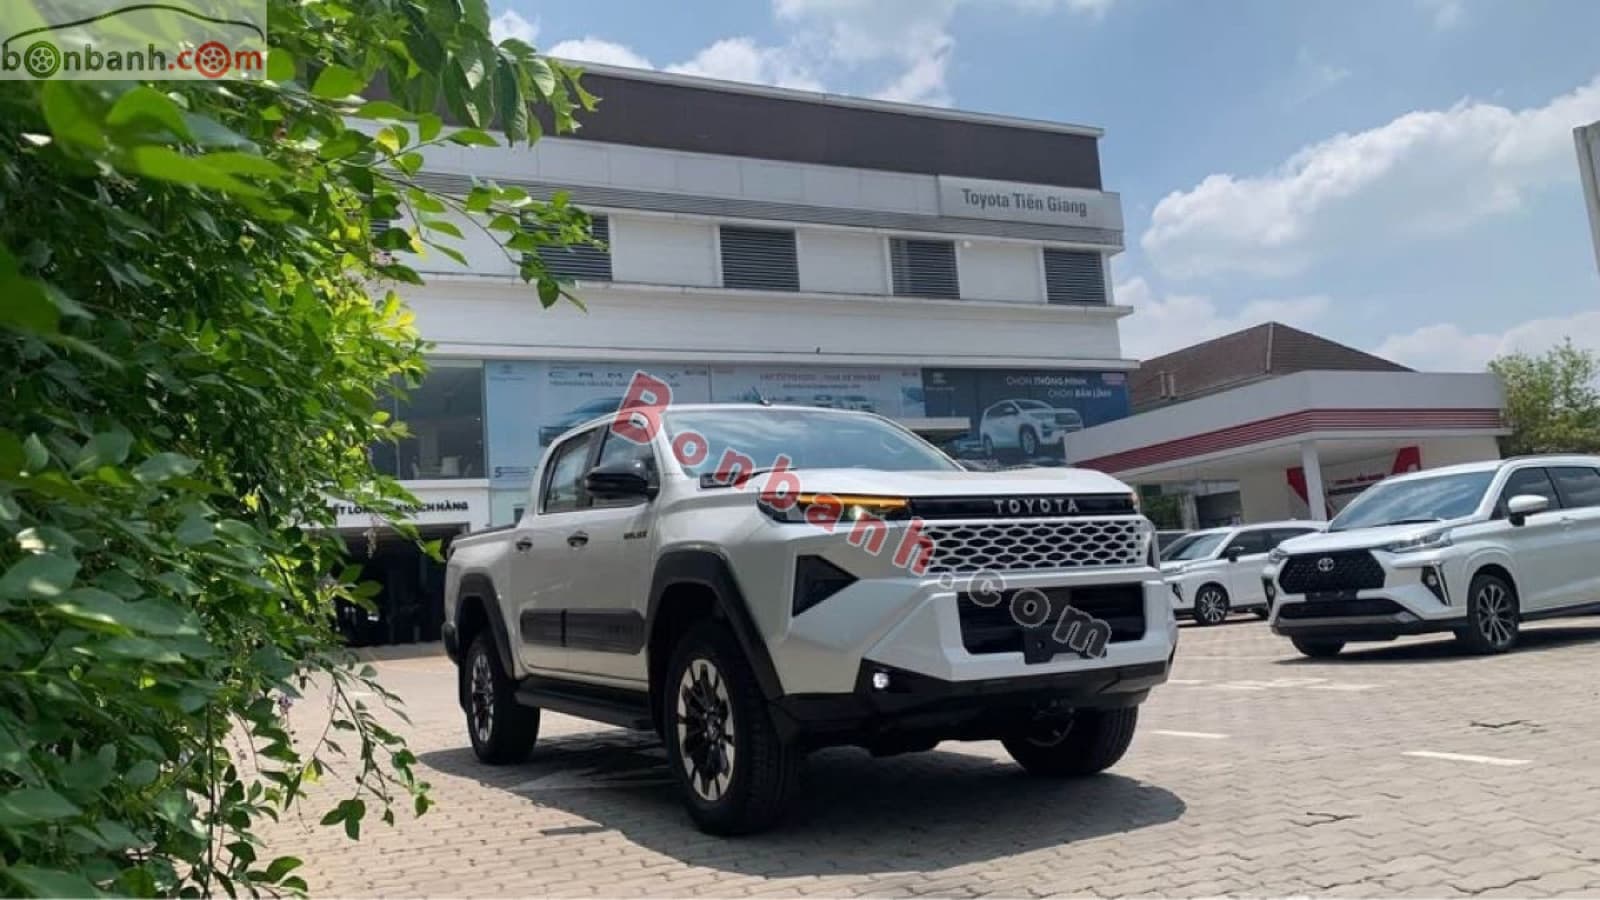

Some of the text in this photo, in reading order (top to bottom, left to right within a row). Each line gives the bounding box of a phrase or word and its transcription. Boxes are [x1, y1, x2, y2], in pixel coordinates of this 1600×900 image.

[961, 188, 1009, 210] Toyota
[1047, 196, 1088, 217] Giang
[436, 499, 469, 512] HÀNG
[993, 498, 1080, 515] TOYOTA
